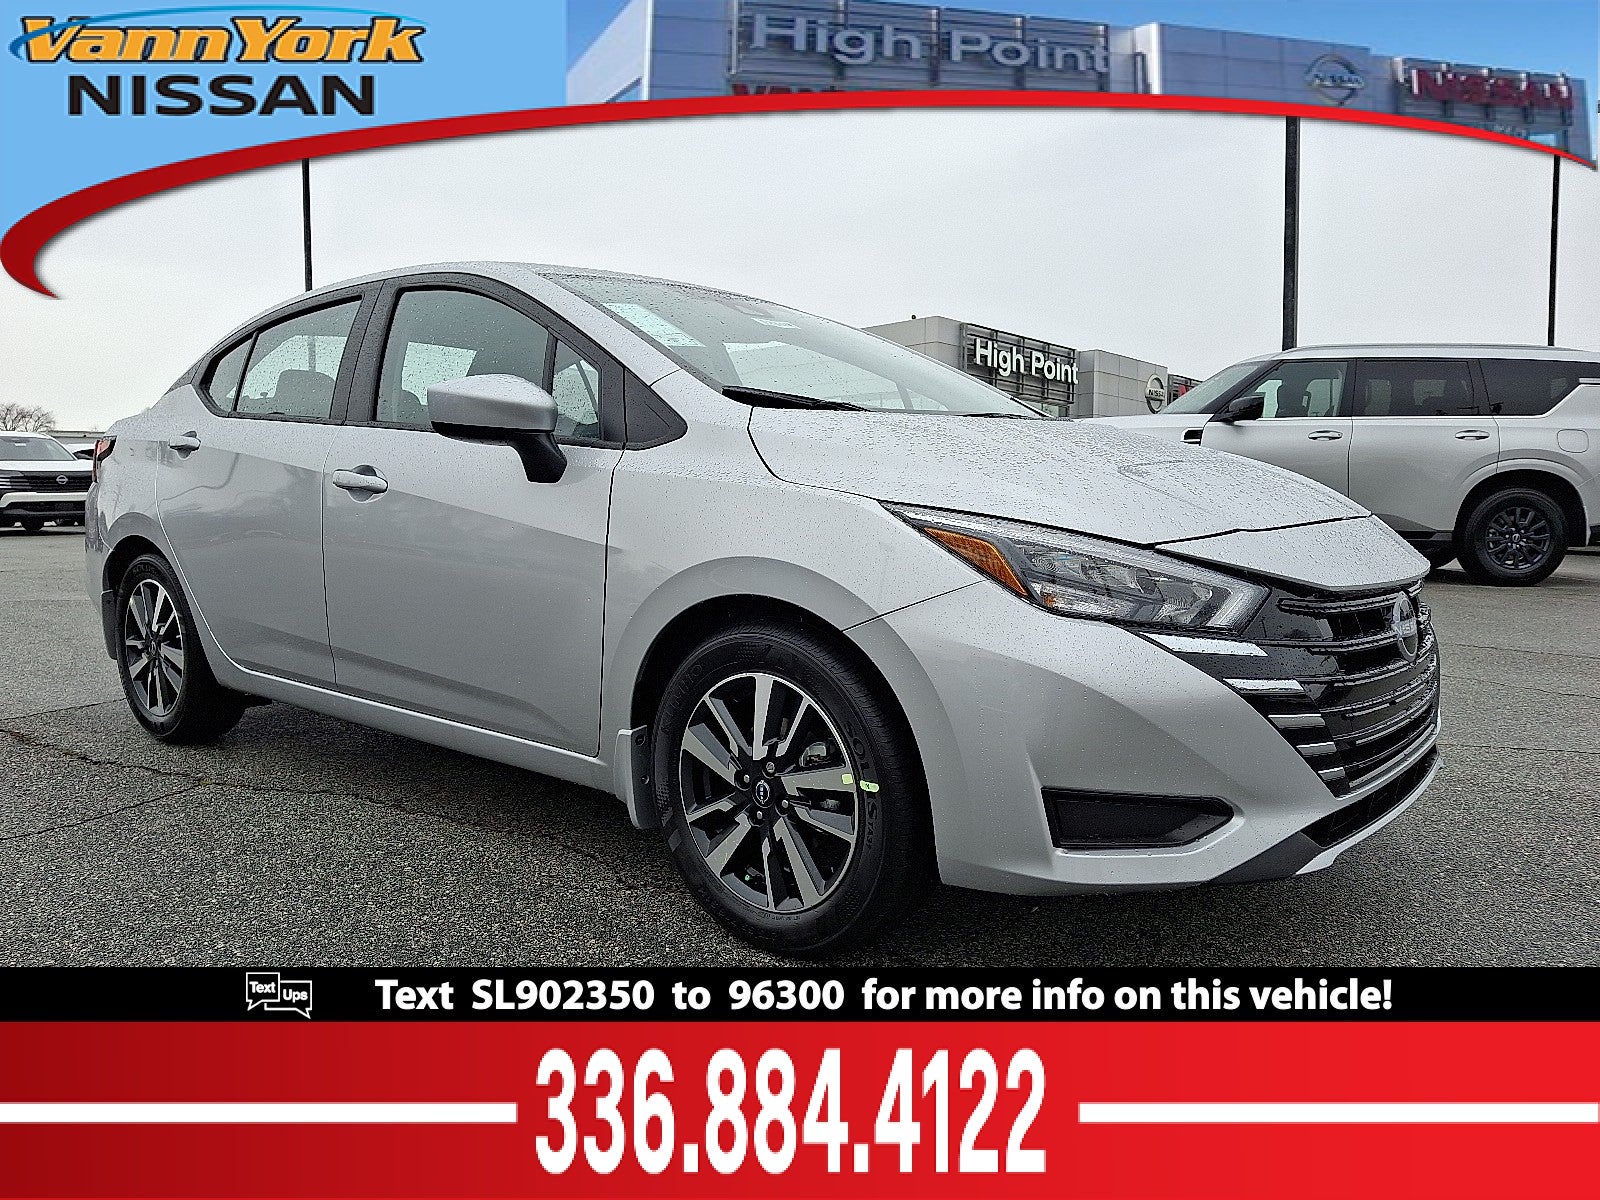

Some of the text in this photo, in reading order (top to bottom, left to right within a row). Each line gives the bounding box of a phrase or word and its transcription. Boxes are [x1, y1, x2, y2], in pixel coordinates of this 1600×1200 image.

[974, 338, 1079, 384] High Point
[847, 722, 878, 817] SOLS
